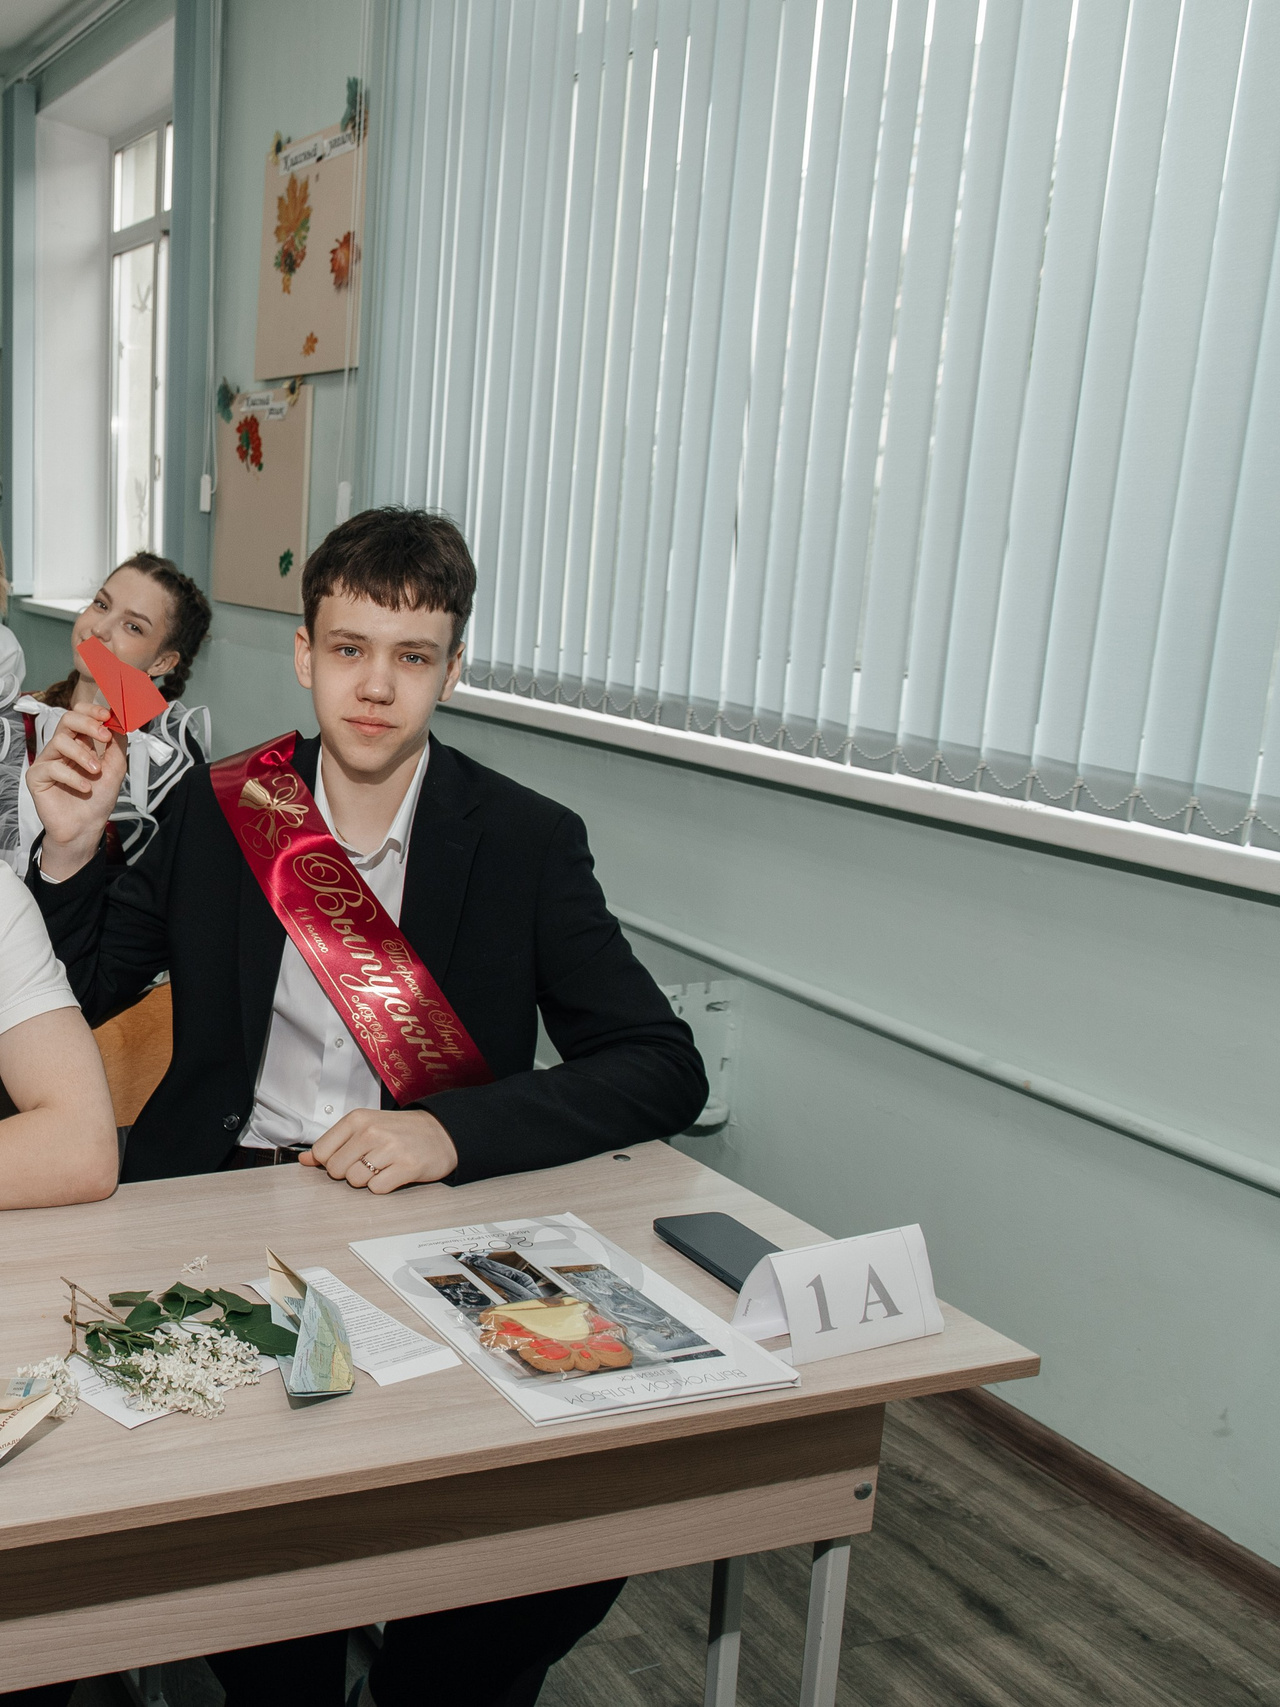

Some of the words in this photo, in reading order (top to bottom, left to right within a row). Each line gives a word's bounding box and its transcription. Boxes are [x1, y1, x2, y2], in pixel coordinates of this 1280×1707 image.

[294, 906, 312, 922] 11
[305, 923, 329, 955] класс
[292, 852, 456, 1089] Выпускни
[428, 1008, 464, 1062] Андр
[805, 1273, 839, 1335] 1
[858, 1263, 904, 1325] А
[563, 1385, 636, 1405] АЛЬБОМ
[640, 1368, 748, 1394] ВЫПУСКНОЙ
